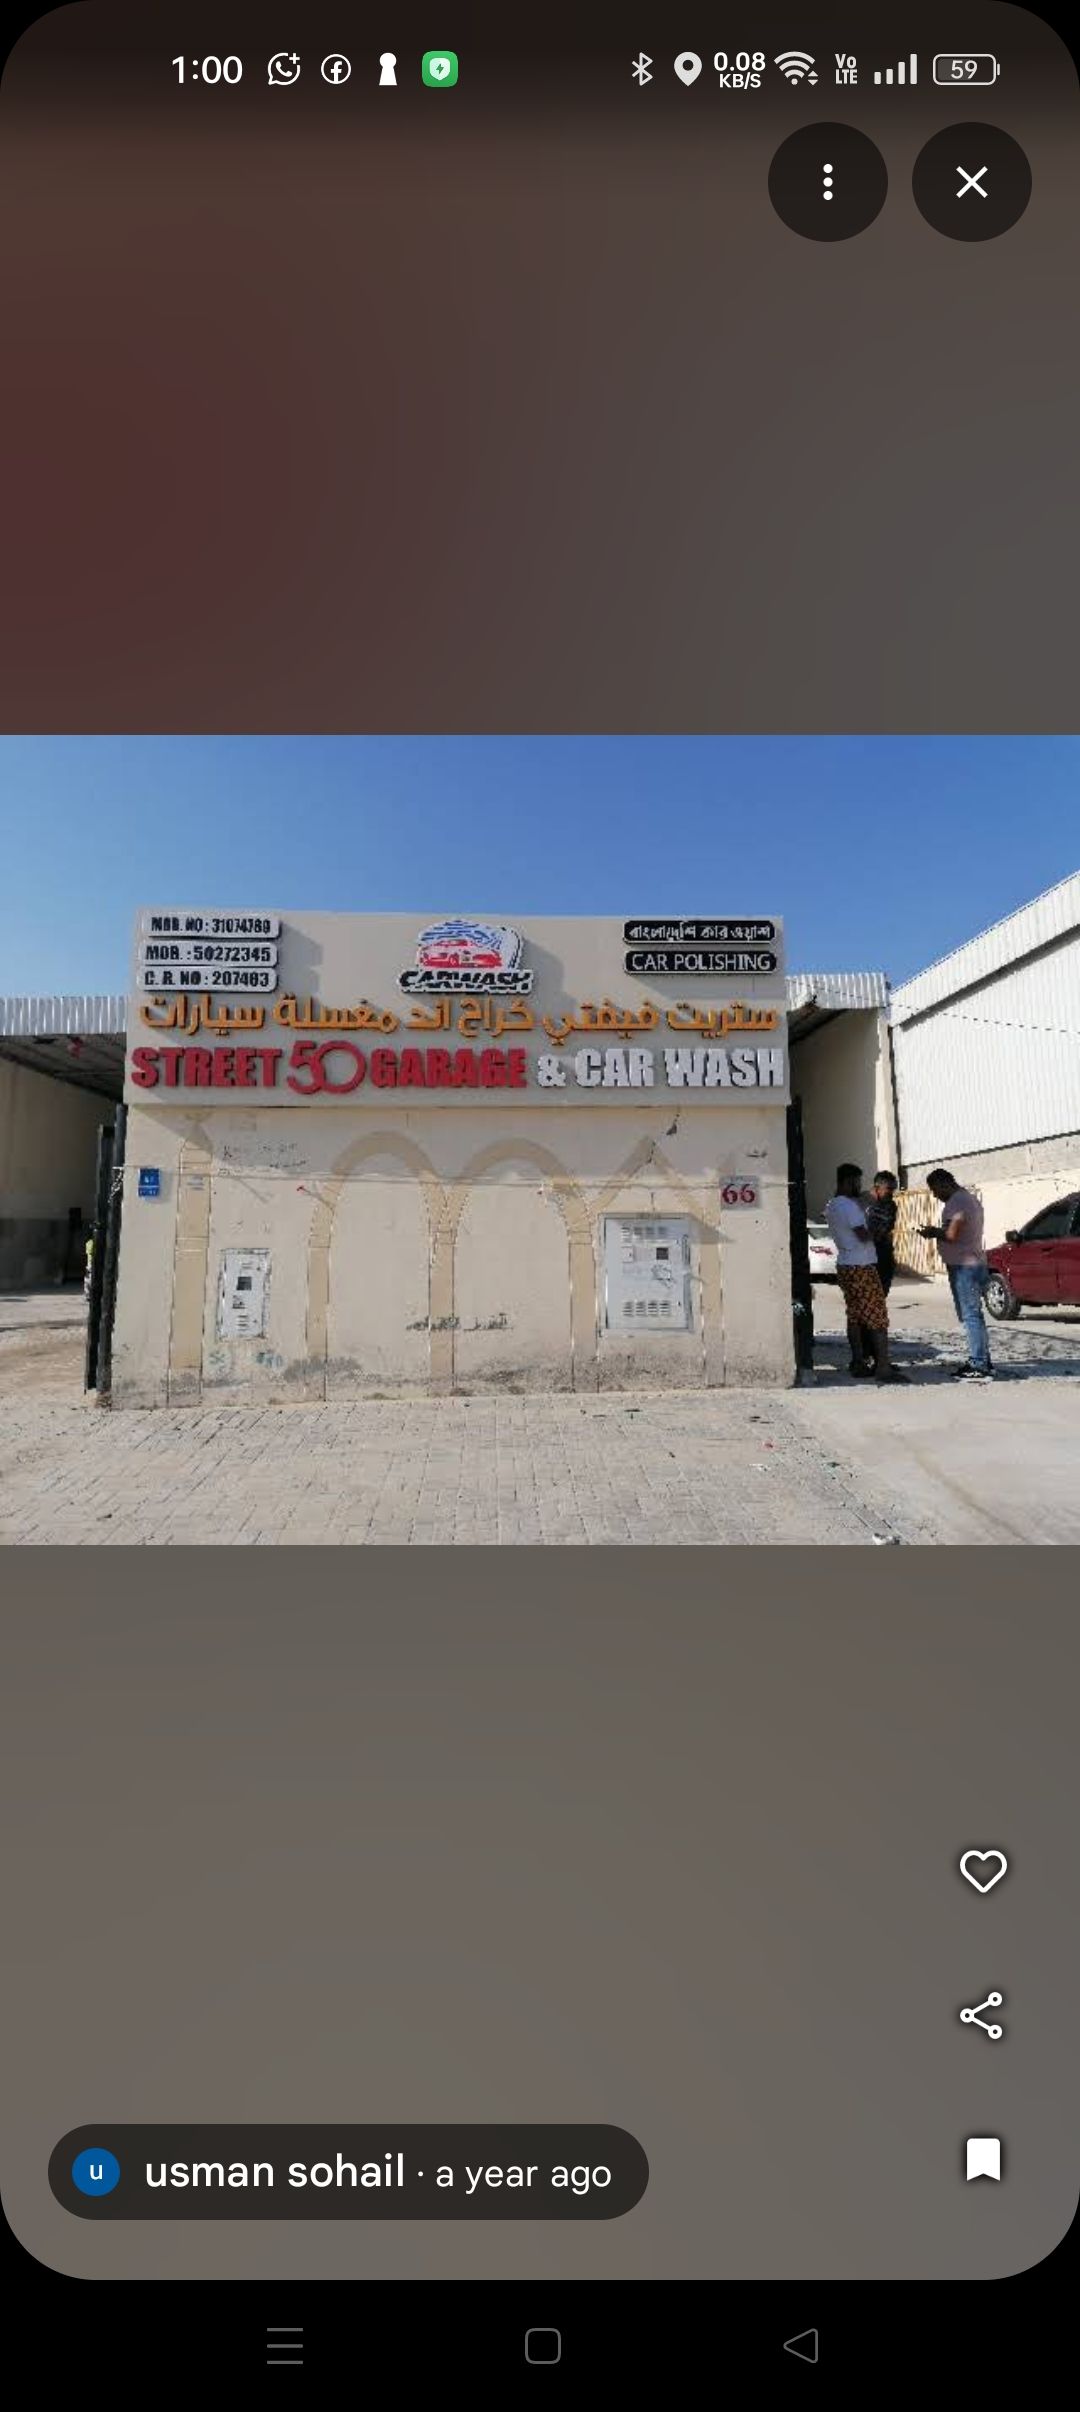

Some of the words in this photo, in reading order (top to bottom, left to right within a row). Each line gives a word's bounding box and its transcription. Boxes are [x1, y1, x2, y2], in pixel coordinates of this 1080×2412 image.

[632, 953, 668, 971] CAR
[674, 953, 771, 971] POLISHING
[140, 993, 266, 1037] سيارات
[272, 993, 399, 1034] مغسلة
[542, 999, 660, 1046] فيفتي
[666, 1001, 779, 1040] ستريت
[130, 1046, 282, 1089] STREET
[286, 1040, 367, 1095] 50
[369, 1047, 528, 1089] GARAGE
[537, 1054, 567, 1088] &
[575, 1048, 655, 1088] CAR
[663, 1047, 785, 1088] WASH
[722, 1183, 756, 1204] 66
